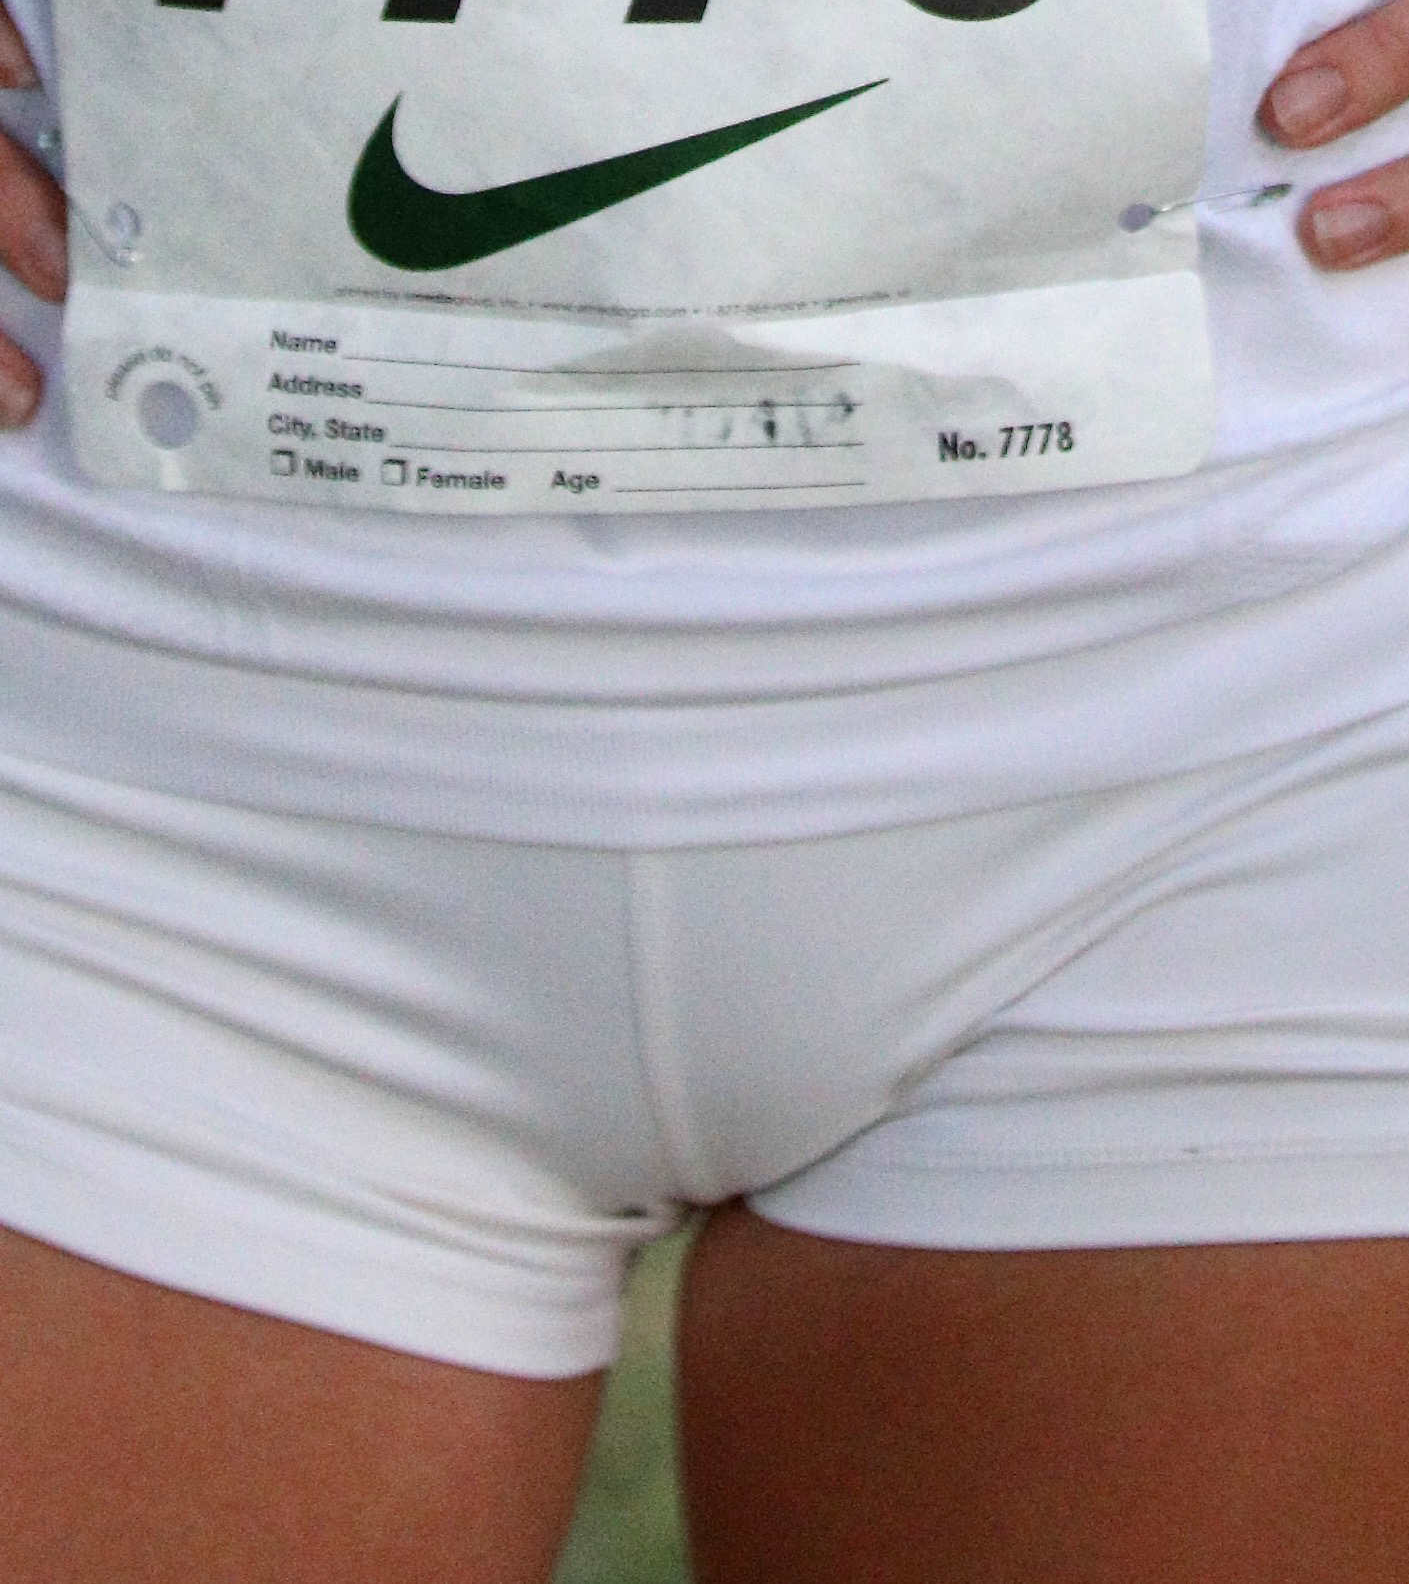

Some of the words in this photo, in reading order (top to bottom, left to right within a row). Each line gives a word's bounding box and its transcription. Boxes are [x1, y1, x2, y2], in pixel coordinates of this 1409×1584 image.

[270, 330, 338, 354] Name
[268, 372, 364, 399] Address
[324, 417, 386, 443] State
[938, 430, 988, 462] No.
[999, 421, 1075, 459] 7778
[304, 456, 361, 482] Male
[415, 466, 507, 491] Female
[550, 468, 601, 495] Age
